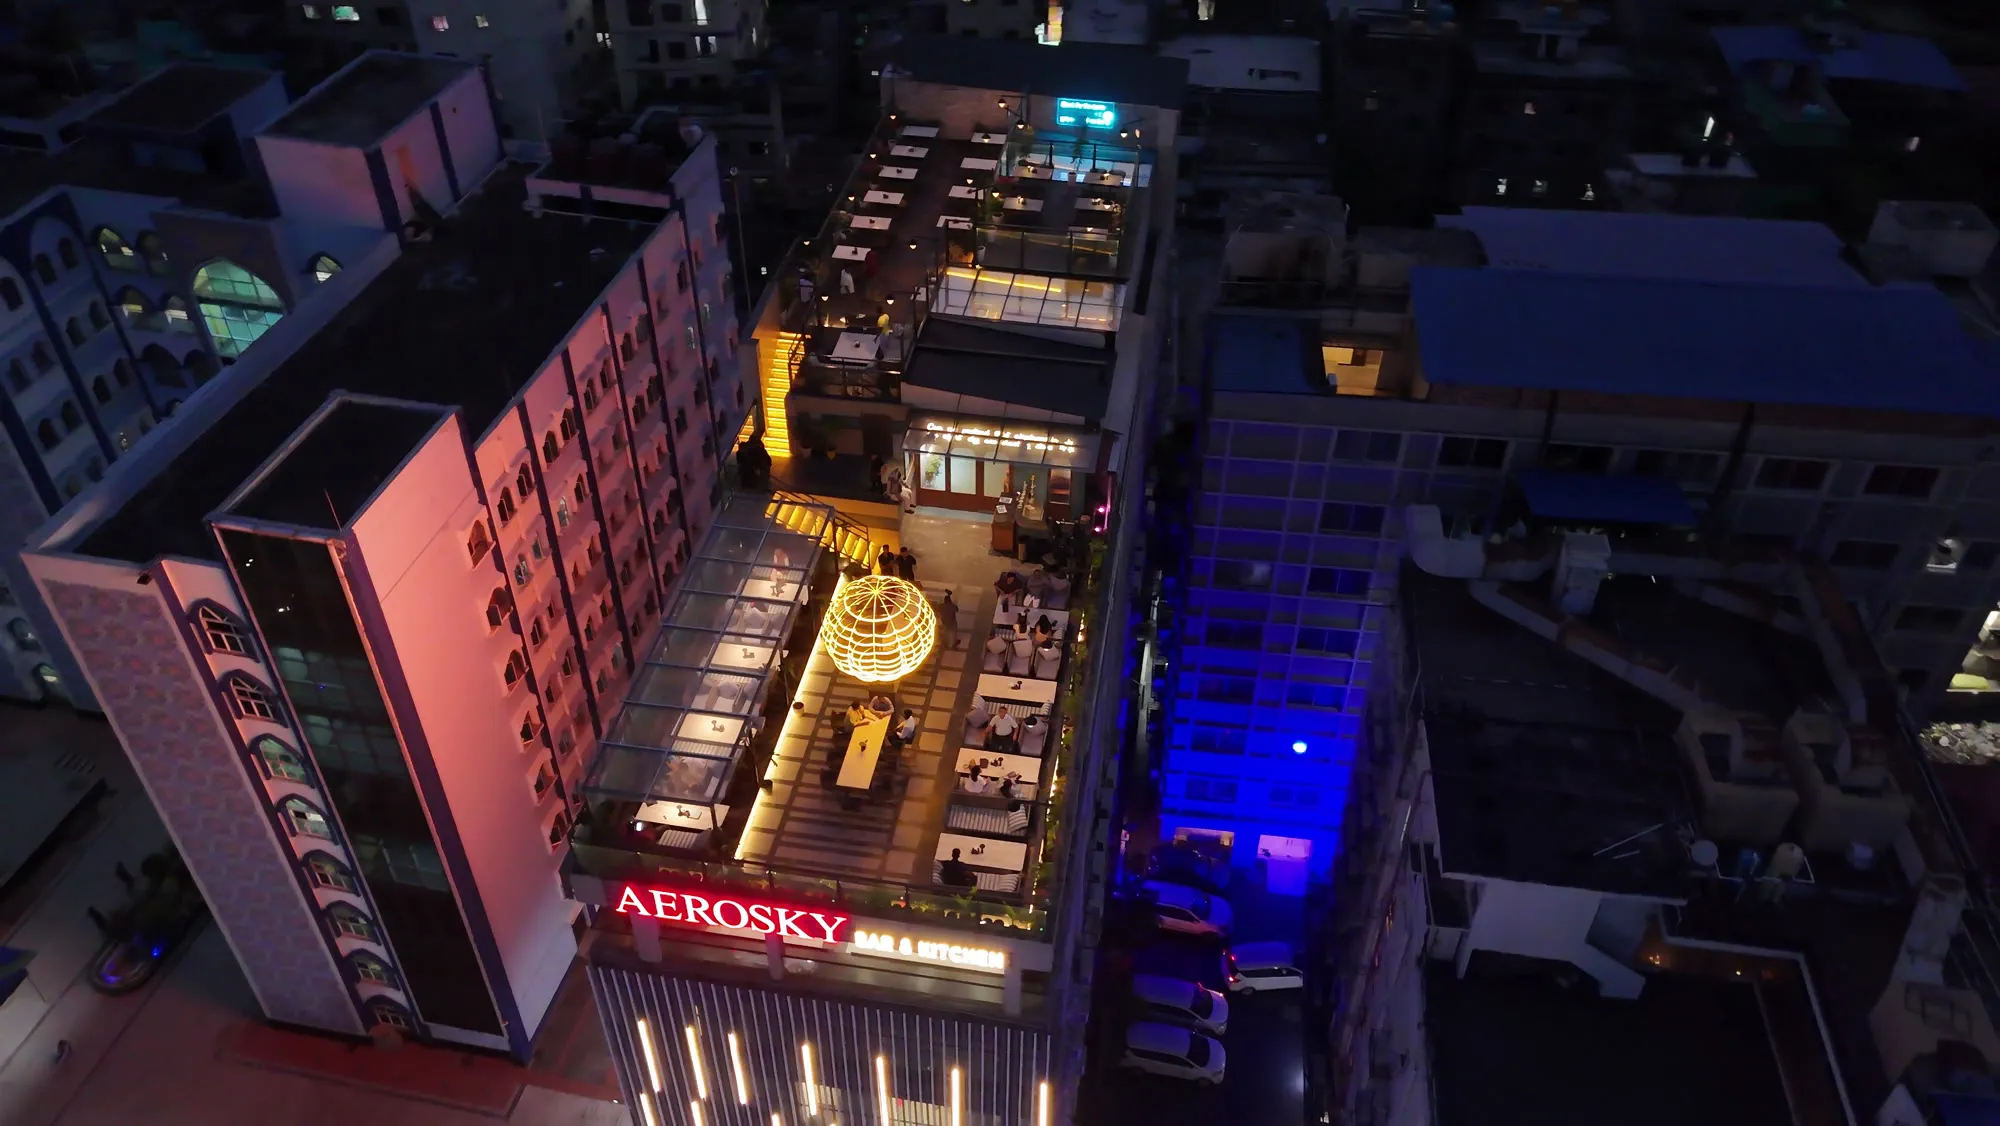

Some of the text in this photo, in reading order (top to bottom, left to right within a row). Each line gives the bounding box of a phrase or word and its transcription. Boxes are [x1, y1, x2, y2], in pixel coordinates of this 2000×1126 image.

[615, 886, 847, 944] AEROSKY
[854, 930, 1004, 969] BAR & KITCHEN
